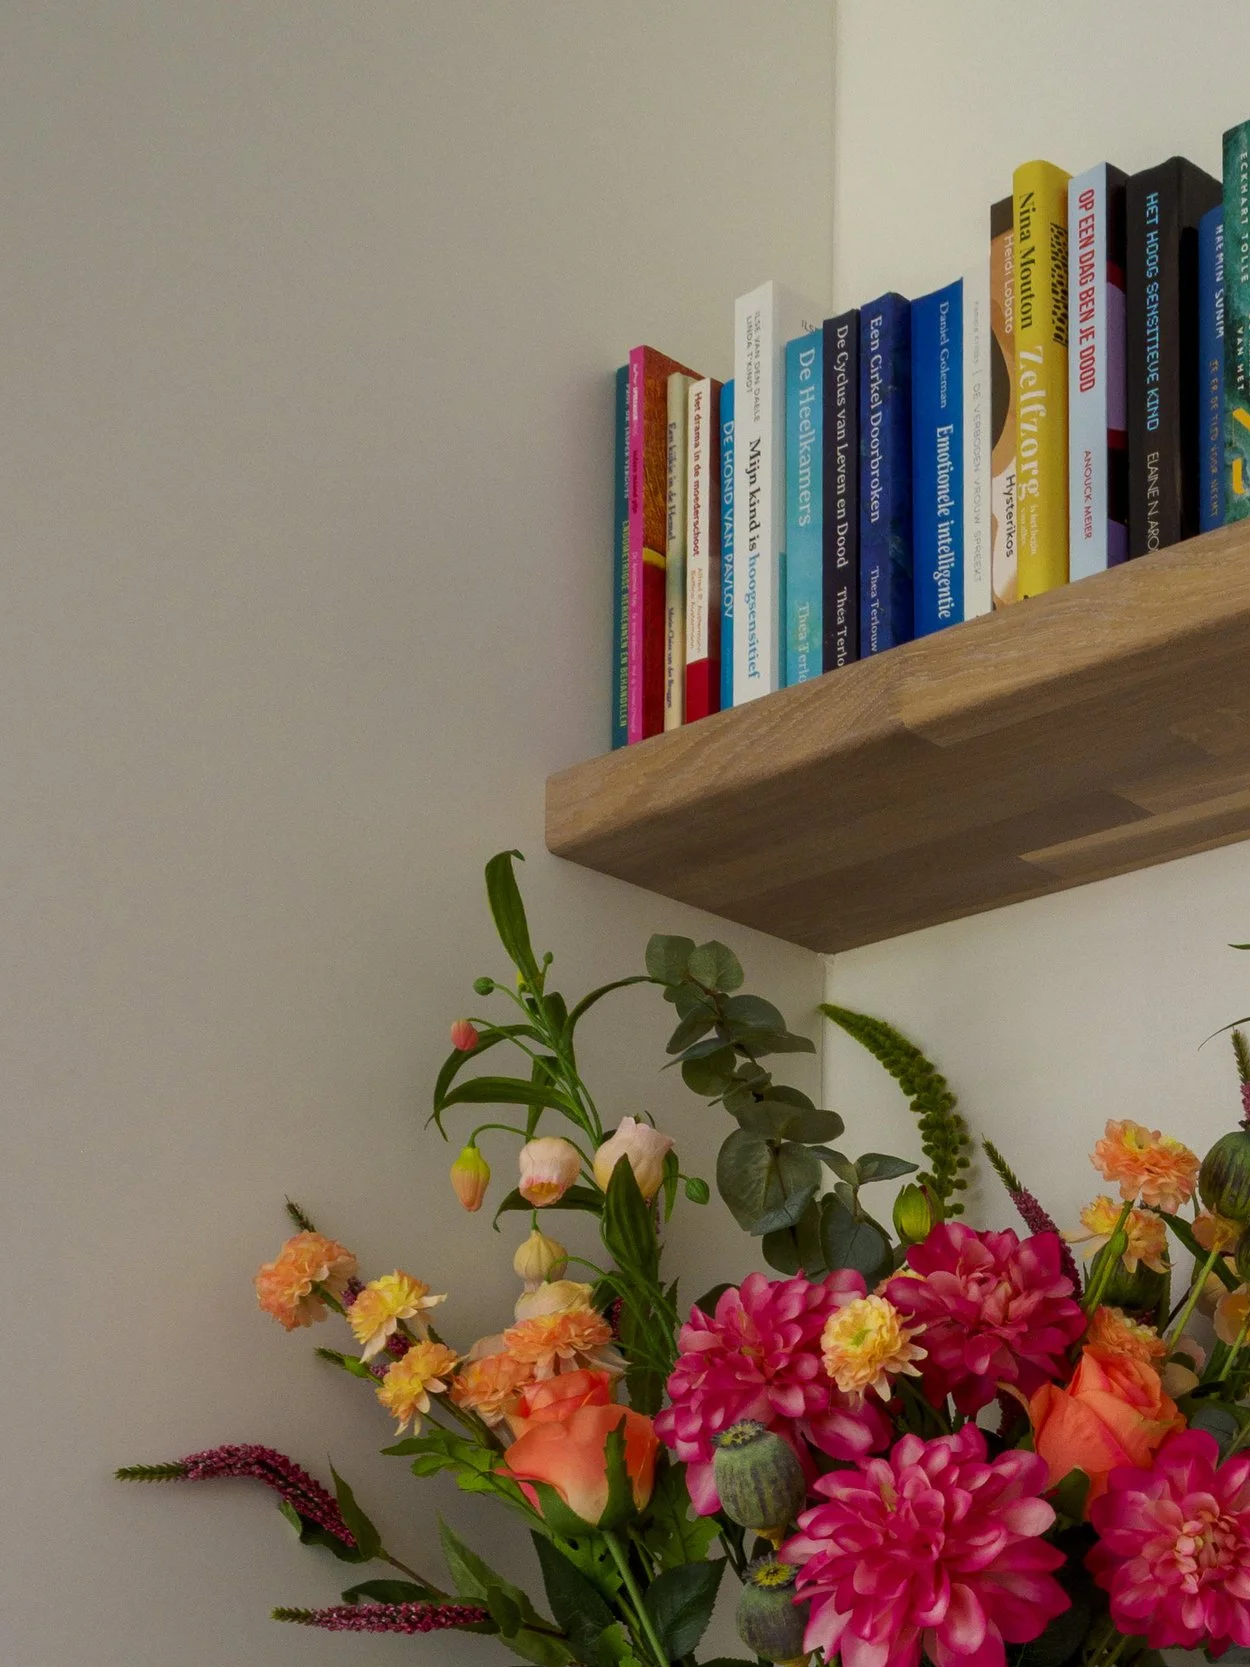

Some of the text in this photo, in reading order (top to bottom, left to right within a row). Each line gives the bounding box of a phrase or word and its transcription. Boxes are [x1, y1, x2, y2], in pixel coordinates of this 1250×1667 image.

[1019, 191, 1036, 331] Nina Mouton
[1239, 152, 1250, 284] ECKHART TOLLE
[1004, 233, 1015, 335] Heidi Lobato
[1077, 188, 1096, 393] OP EEN DAG BEN JE DOOD
[1146, 191, 1160, 432] HET HOOG SENSITIEVE KIND
[1214, 223, 1225, 340] HAEMIN SUNIM
[753, 336, 761, 360] VAN
[753, 361, 761, 386] DEN
[799, 346, 816, 382] De
[939, 300, 950, 409] Daniel Goleman
[1236, 325, 1245, 392] VAN HET
[692, 391, 703, 557] Het drama in de moederschoot
[798, 384, 816, 527] Heelkamers
[833, 324, 849, 569] De Cyclus van Leven en Dood
[869, 315, 883, 524] Een Cirkel Doorbroken
[1017, 345, 1047, 502] Zelfzorg
[723, 419, 734, 619] DE HOND VAN PAVLOV
[932, 423, 955, 620] Emotionele intelligentie
[1002, 473, 1016, 558] Hysterikos
[1083, 450, 1093, 541] ANOUCK MEIER
[1146, 451, 1160, 500] ELAINE
[744, 438, 762, 680] Mijn kind is hoogsensitief
[1146, 520, 1160, 555] ARO
[797, 601, 810, 641] Thea
[836, 586, 848, 625] Thea
[870, 565, 880, 653] Thea Terlouw
[619, 666, 629, 728] BEHANDELEN
